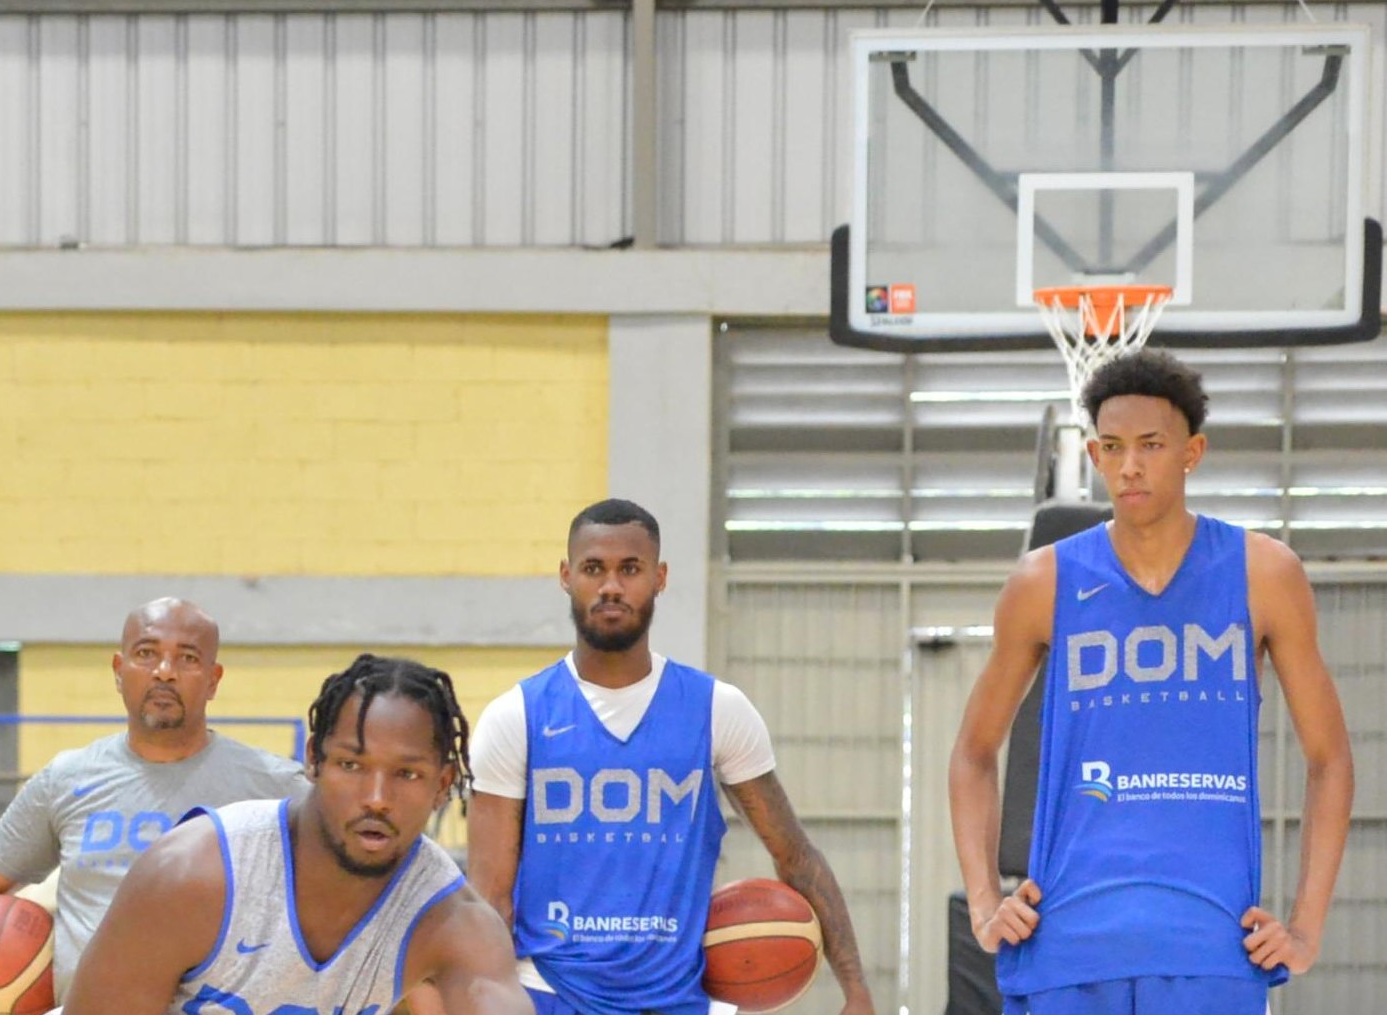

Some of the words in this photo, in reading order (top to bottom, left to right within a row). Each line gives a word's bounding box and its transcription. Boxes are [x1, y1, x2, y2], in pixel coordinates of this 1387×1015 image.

[1067, 623, 1247, 692] DOM
[1070, 690, 1245, 712] BASKETBALL
[532, 767, 704, 825] DOM
[1117, 772, 1247, 791] BANRESERVAS
[80, 810, 173, 854] DO
[537, 832, 684, 844] BASKETBAL
